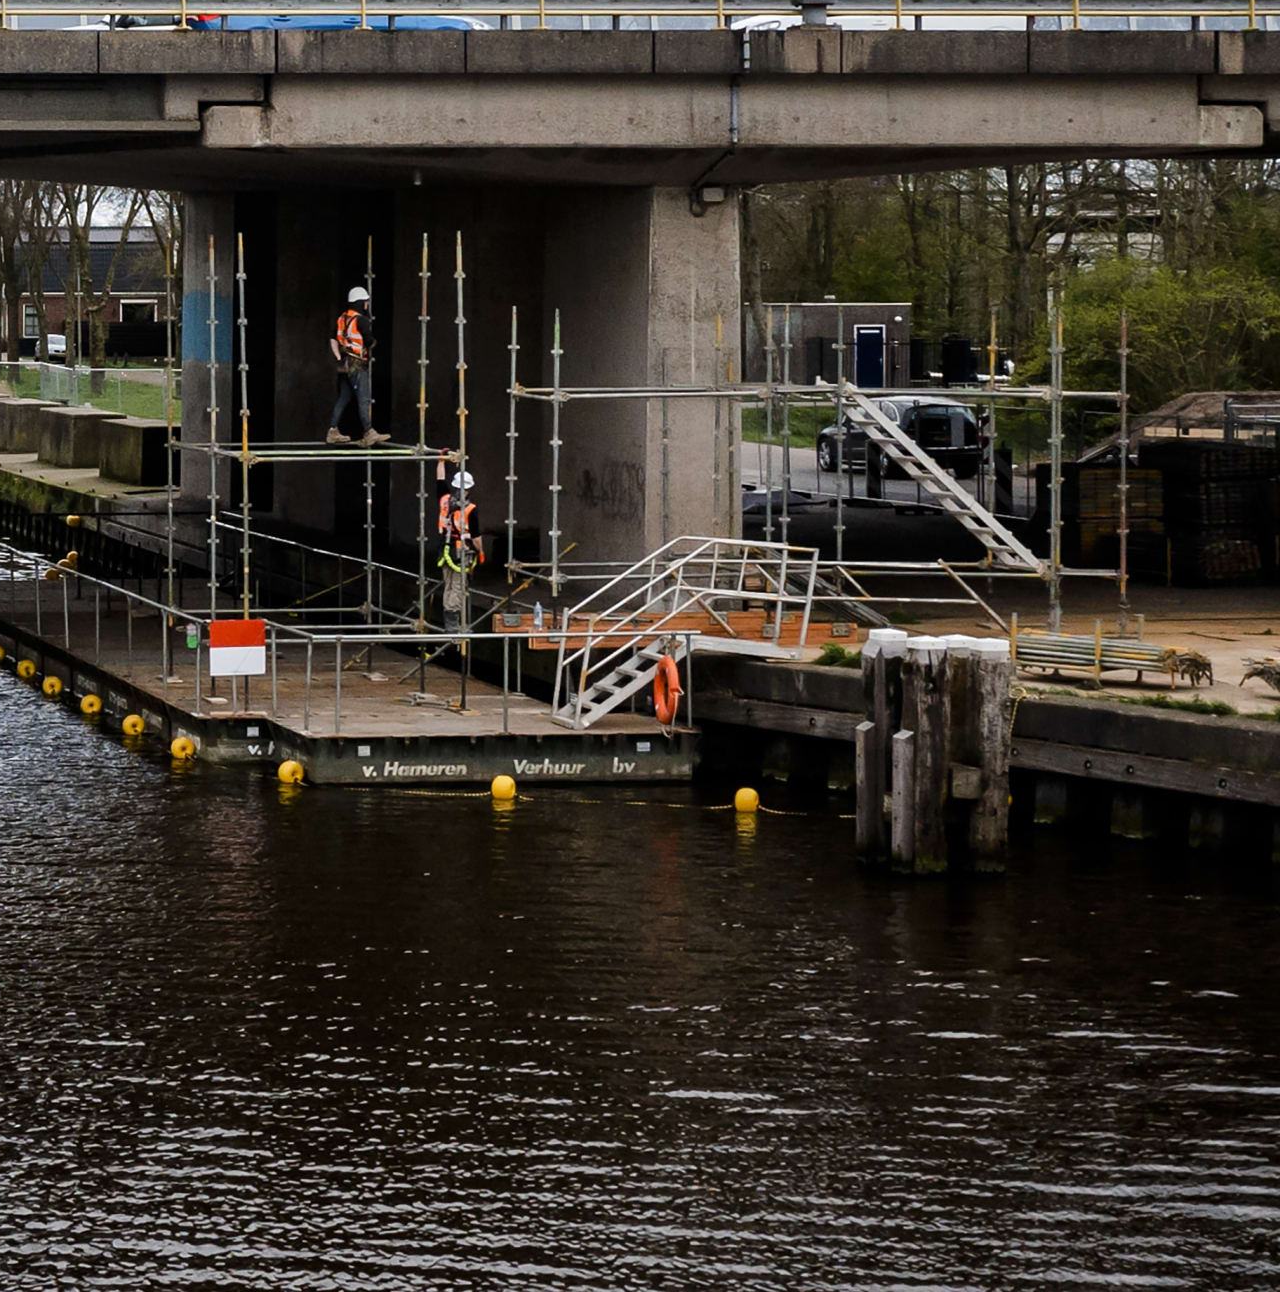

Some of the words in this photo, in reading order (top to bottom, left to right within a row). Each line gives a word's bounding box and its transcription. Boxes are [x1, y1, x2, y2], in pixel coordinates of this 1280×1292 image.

[362, 766, 377, 778] v.
[513, 758, 586, 775] Verhuur
[612, 756, 636, 774] bv
